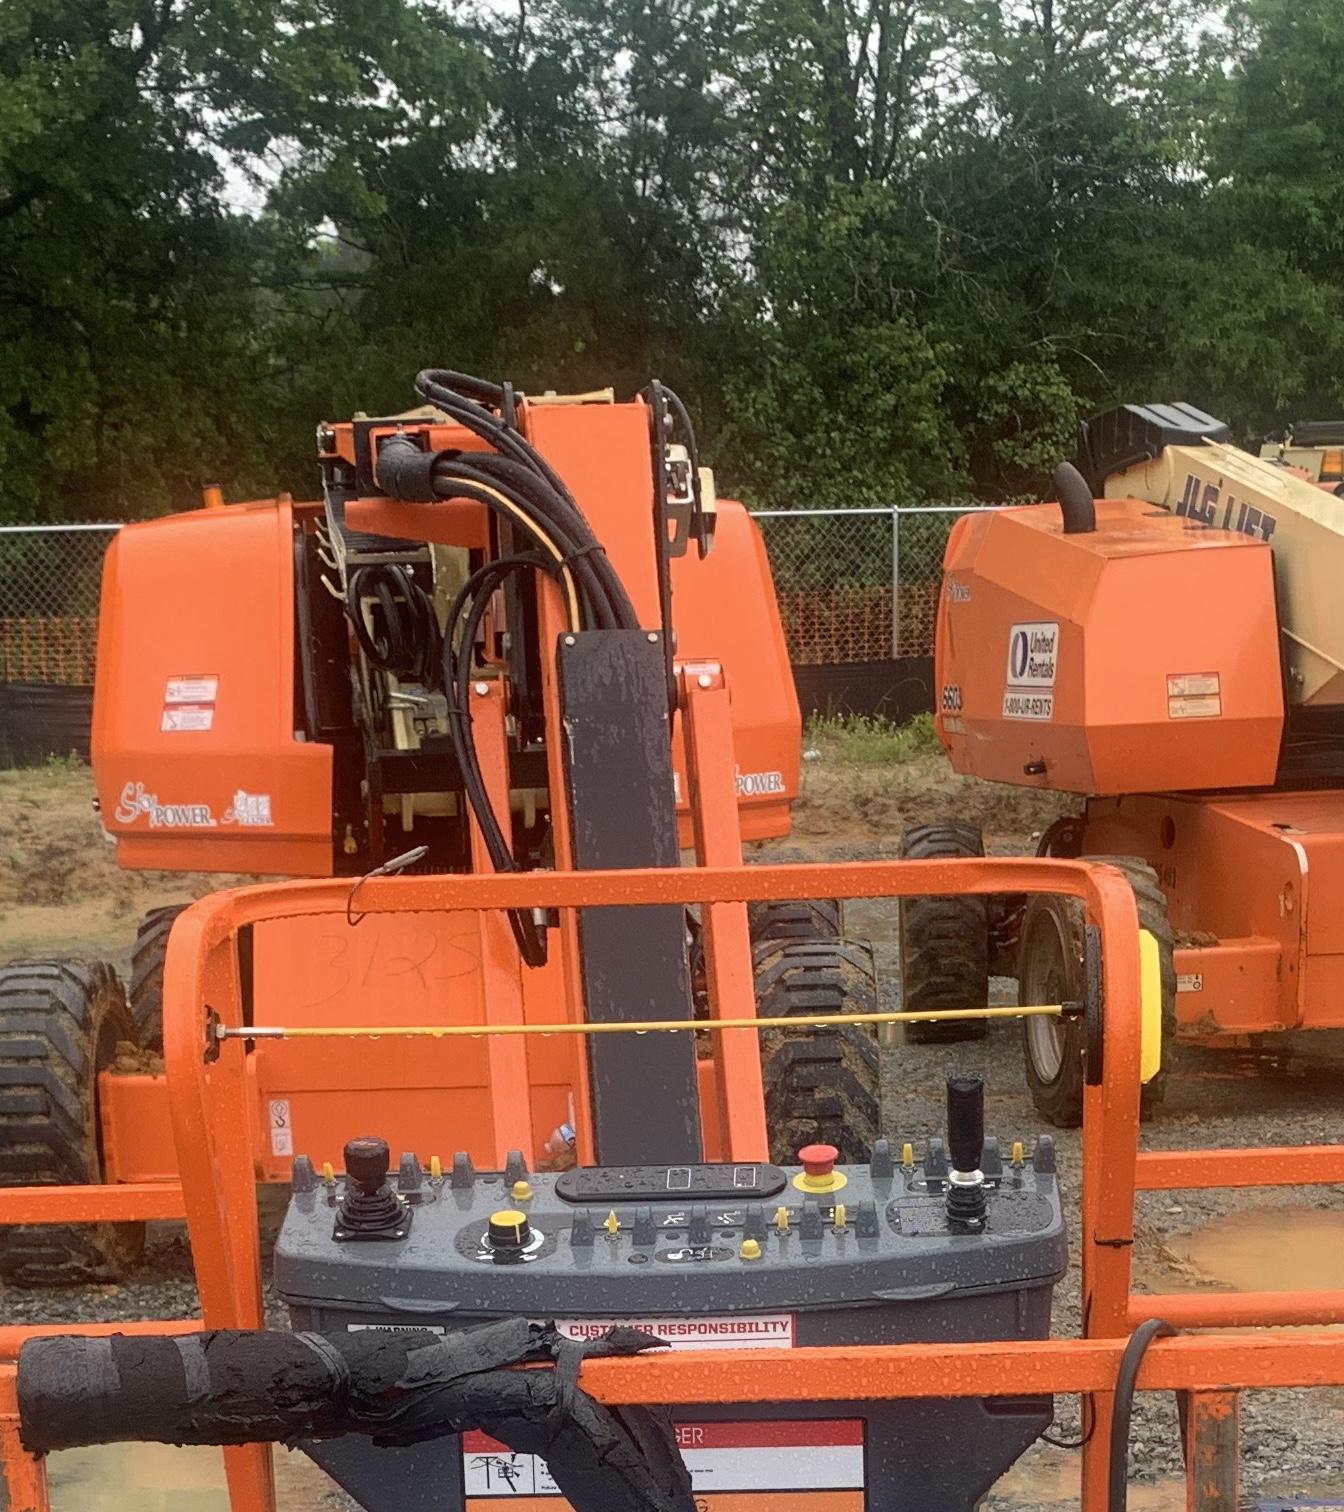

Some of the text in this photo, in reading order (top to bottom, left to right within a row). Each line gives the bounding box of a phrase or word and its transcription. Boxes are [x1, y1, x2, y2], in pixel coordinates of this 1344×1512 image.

[1030, 632, 1055, 653] United
[1027, 657, 1054, 678] Rentals
[1005, 698, 1052, 716] 1-800-UR-RENTS
[658, 1321, 789, 1336] RESPONSIBILITY
